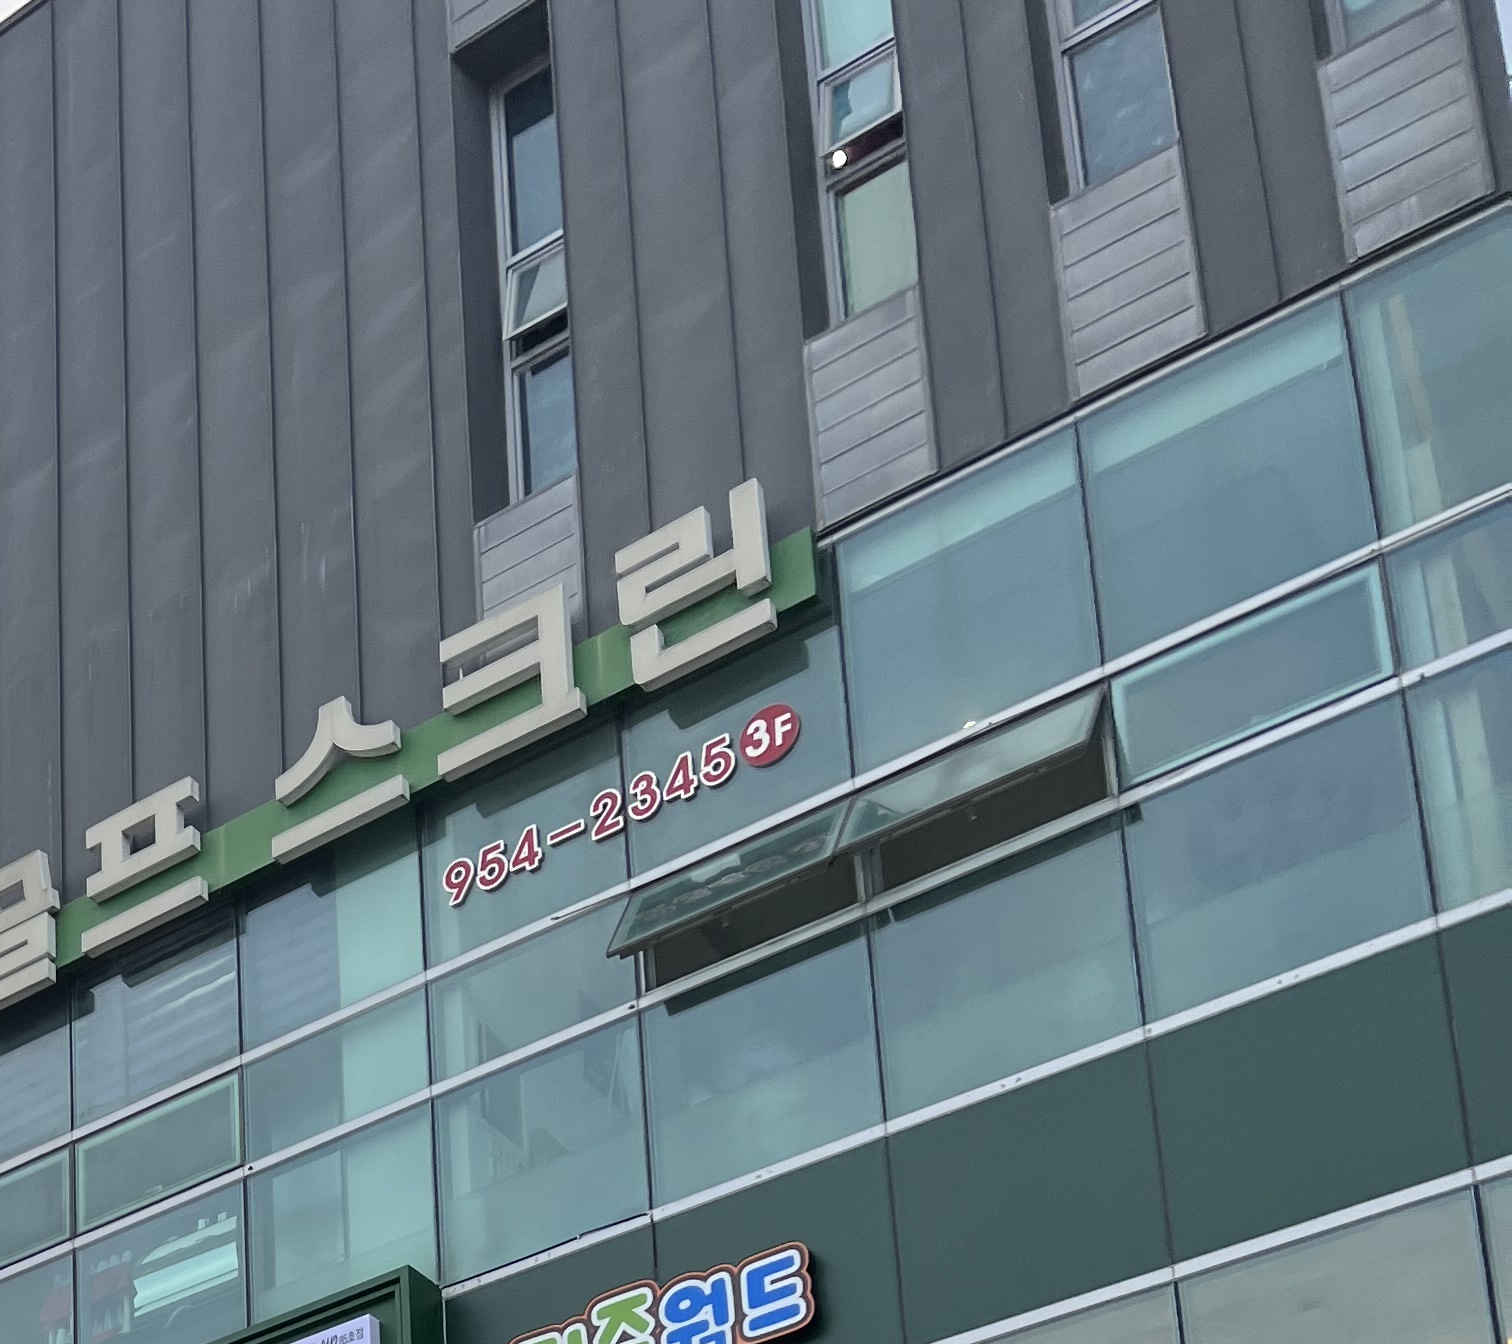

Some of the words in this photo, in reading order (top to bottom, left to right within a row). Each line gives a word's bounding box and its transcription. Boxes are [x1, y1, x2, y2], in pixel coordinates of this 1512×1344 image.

[272, 478, 778, 864] 스크린
[442, 733, 736, 906] 954-2345
[744, 708, 797, 760] 3F
